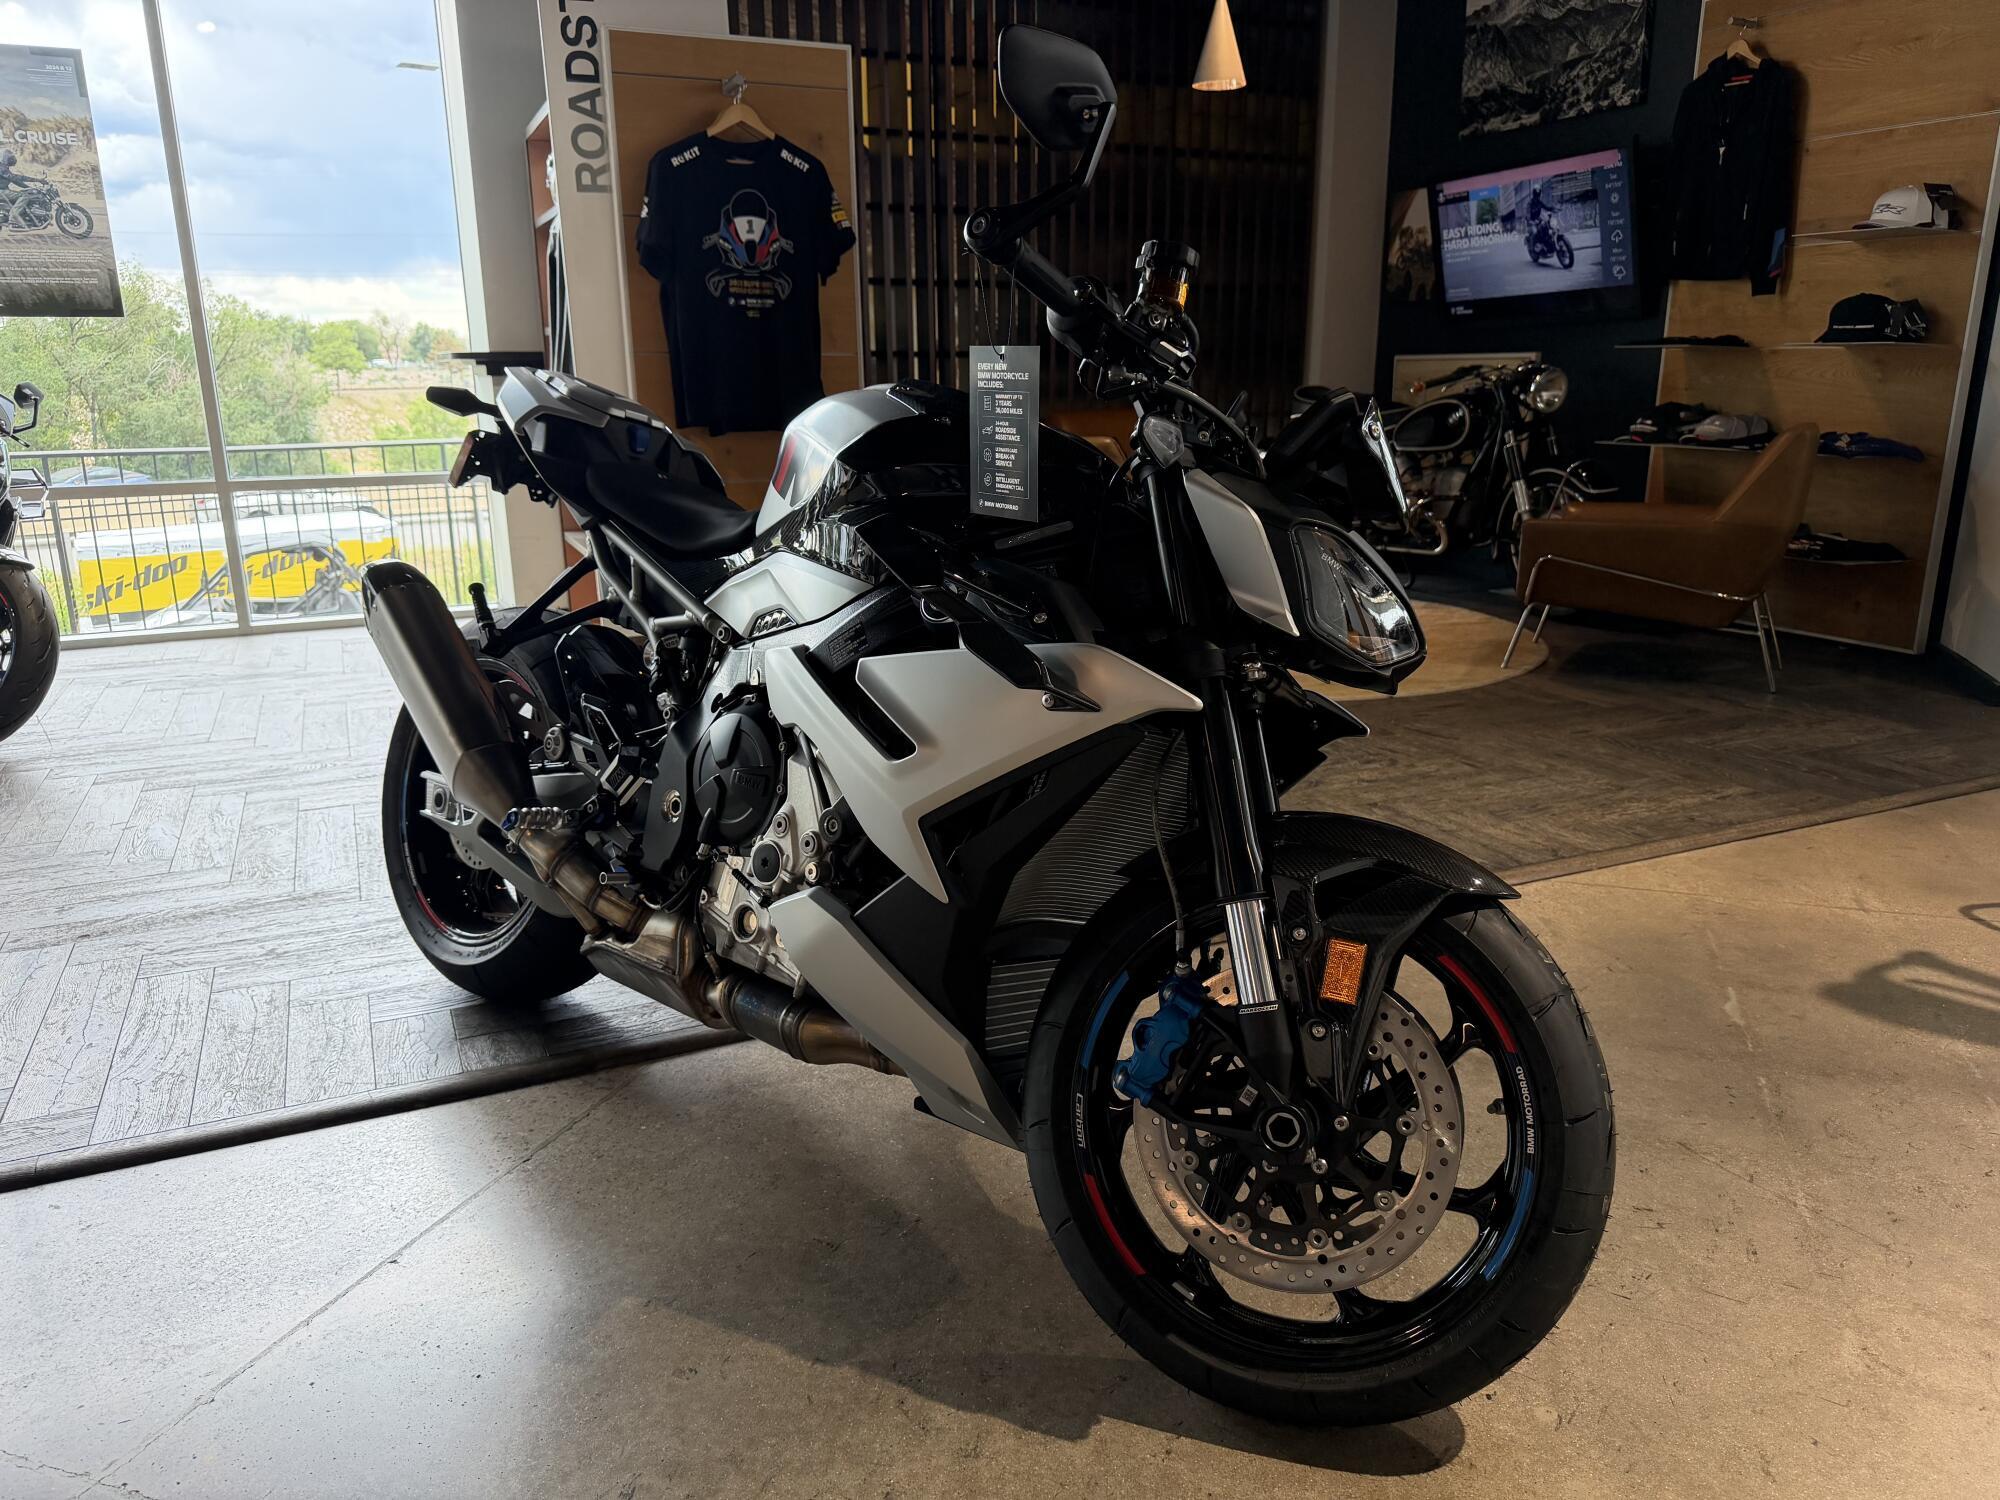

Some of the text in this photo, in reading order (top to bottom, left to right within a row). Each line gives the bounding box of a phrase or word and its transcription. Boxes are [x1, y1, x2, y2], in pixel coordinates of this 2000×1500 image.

[746, 219, 755, 234] 1
[1442, 221, 1503, 240] EASY RIDING,
[1443, 236, 1469, 251] HARD
[977, 362, 1008, 371] EVERY NEW
[977, 371, 1030, 380] BMW MOTORCYCLE
[977, 380, 1004, 389] INCLUDES:
[995, 399, 999, 407] 3
[1009, 407, 1023, 415] MILES
[995, 426, 1017, 434] ROADSIDE
[995, 433, 1021, 442] ASSISTANCE
[995, 452, 1015, 460] BREAK-IN
[995, 459, 1012, 468] SERVICE
[995, 476, 1020, 485] INTELLIGENT
[995, 482, 1015, 490] EMERGENCY
[994, 502, 1019, 511] MOTORRAD
[1321, 552, 1342, 570] BMW
[1515, 1065, 1536, 1155] BMW MOTORRAD
